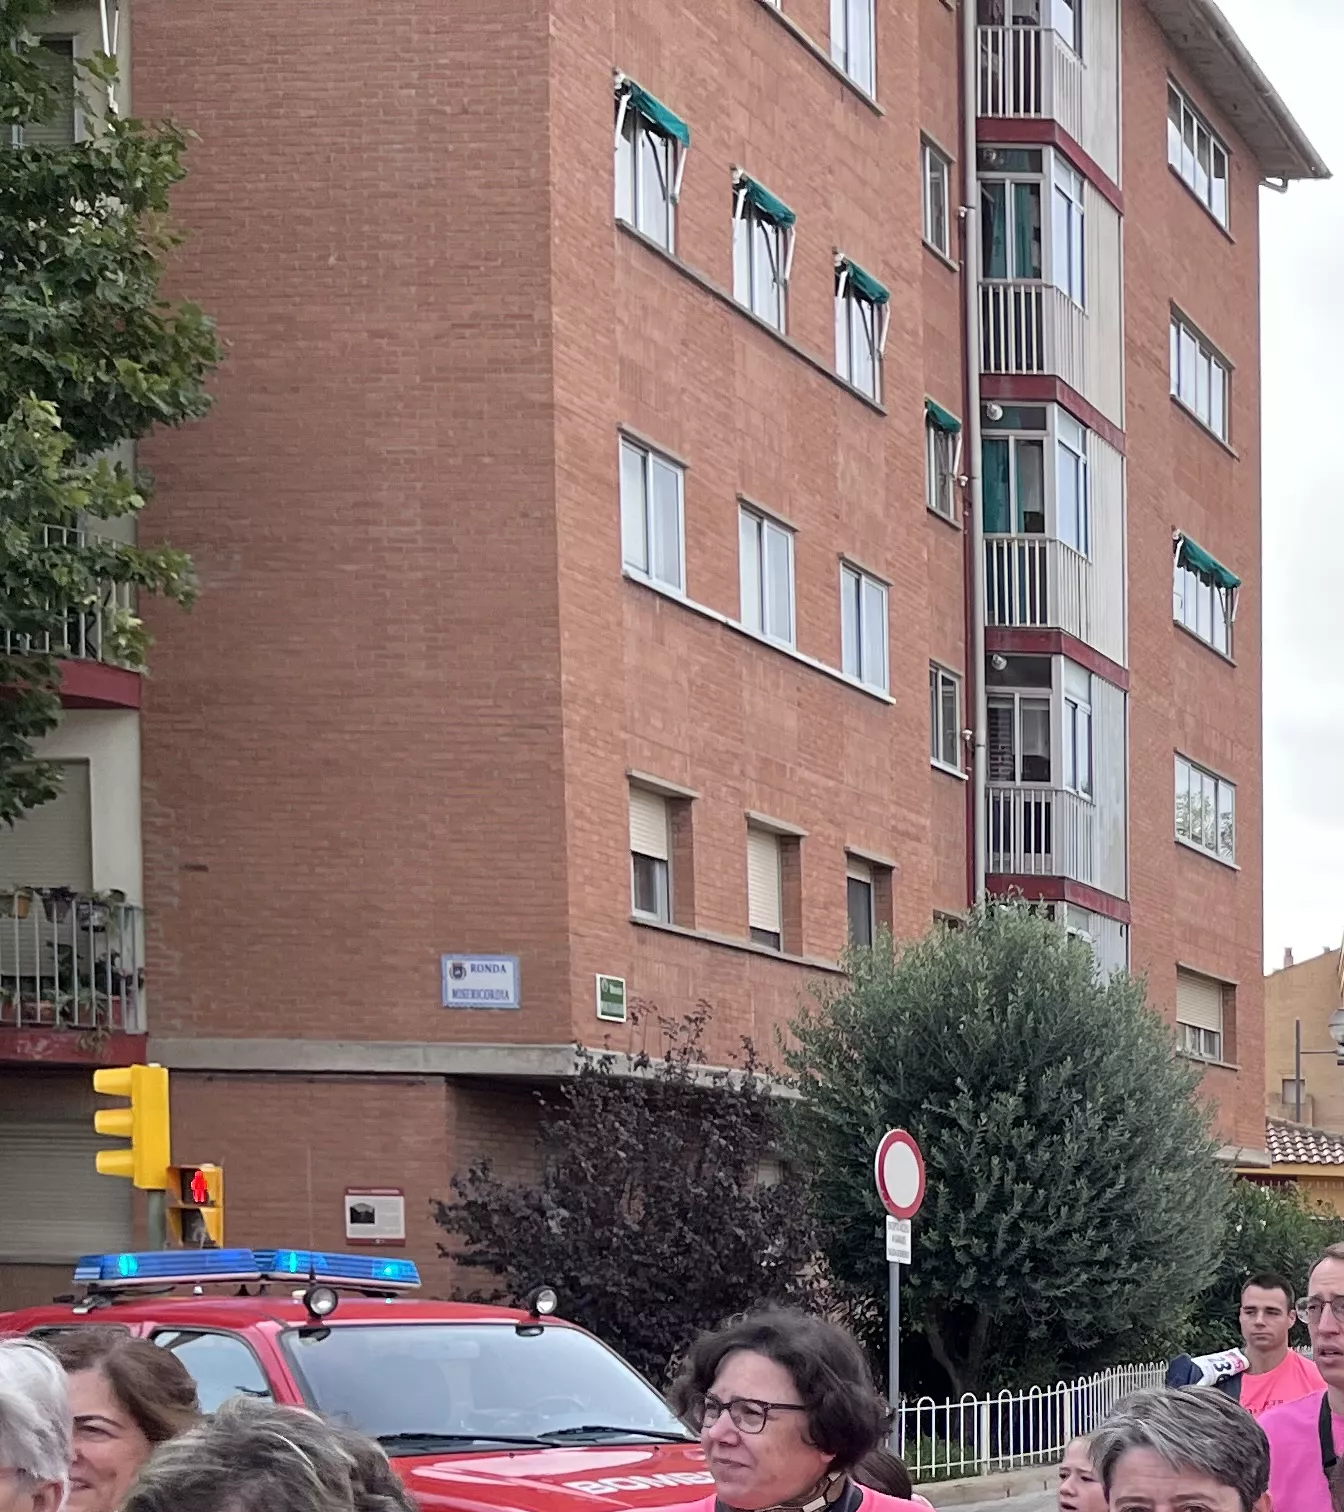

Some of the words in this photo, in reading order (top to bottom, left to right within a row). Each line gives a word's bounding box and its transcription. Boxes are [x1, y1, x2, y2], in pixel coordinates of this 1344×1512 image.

[470, 963, 506, 973] RONDA
[452, 988, 510, 1000] MISERICORDIA
[562, 1471, 715, 1495] BOMB
